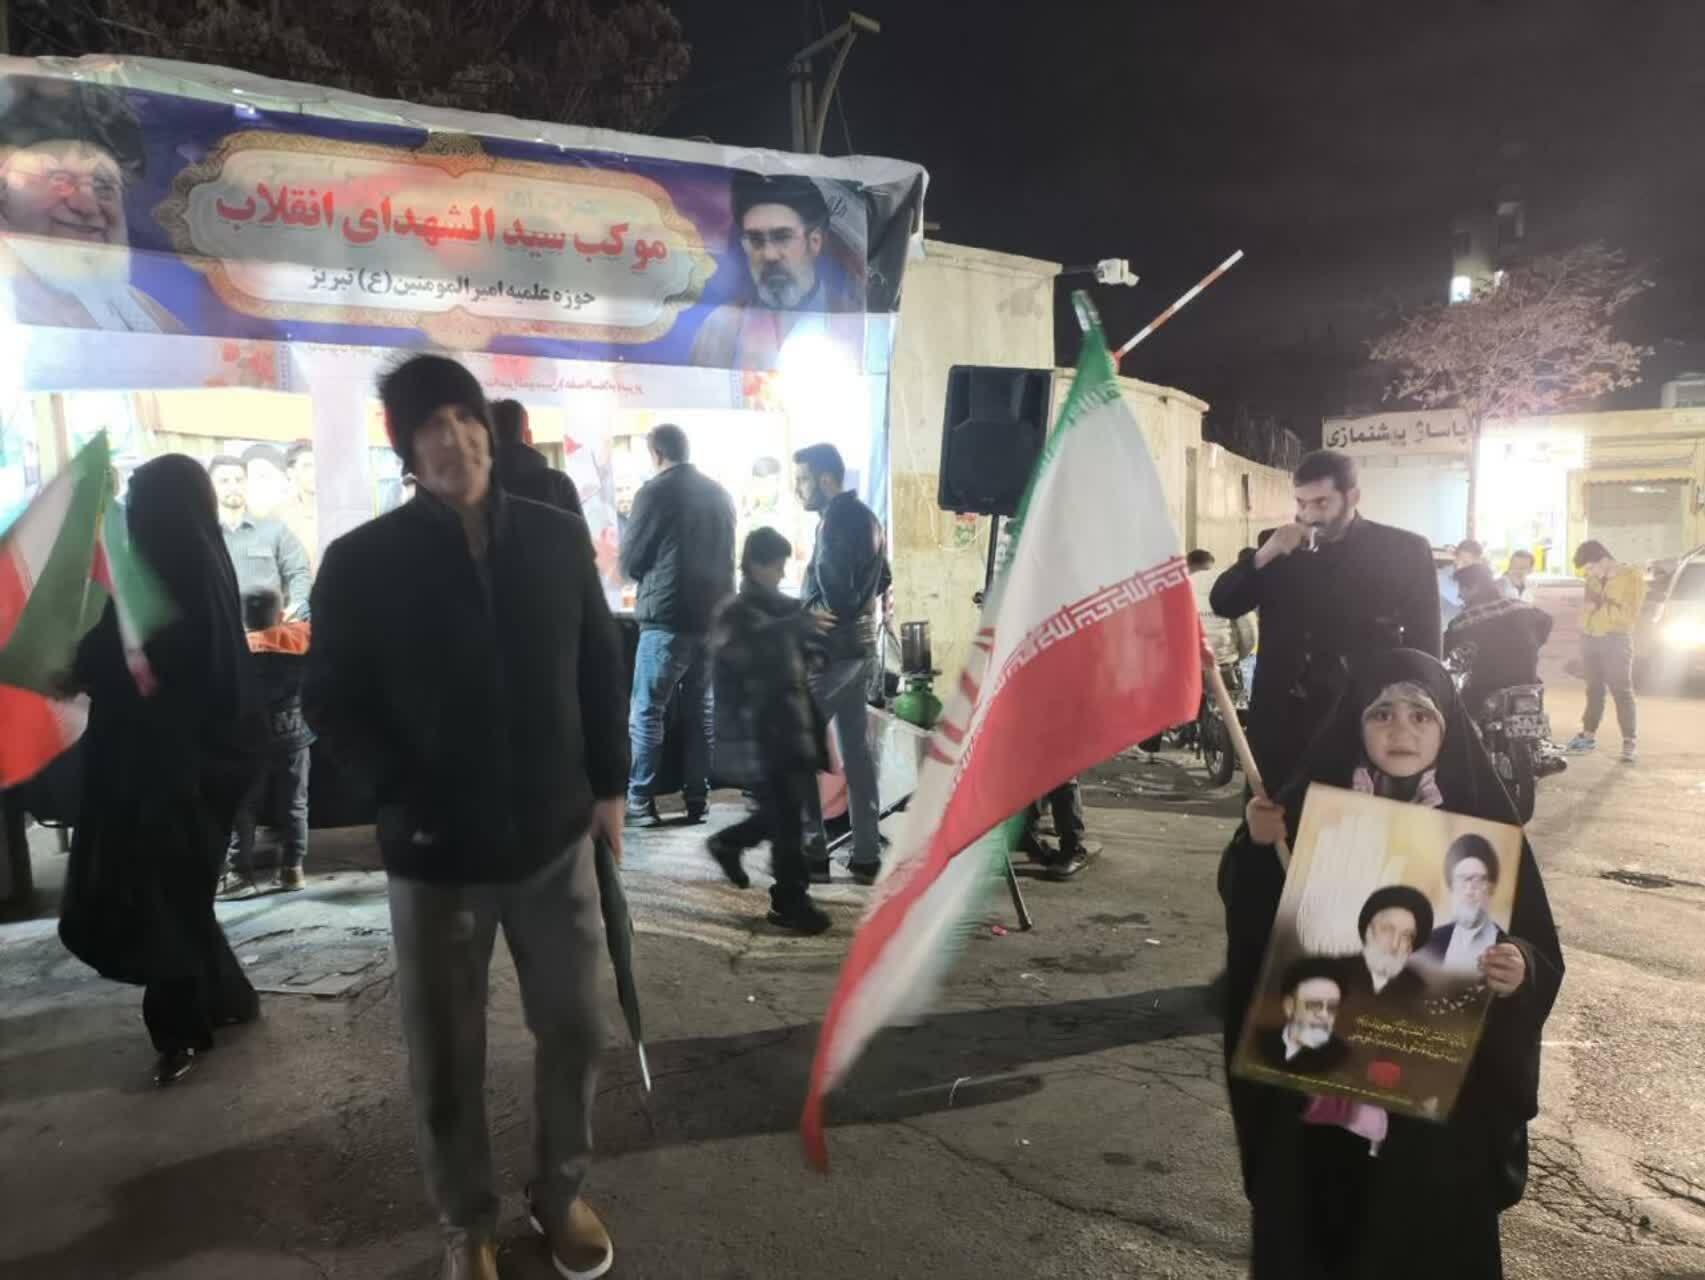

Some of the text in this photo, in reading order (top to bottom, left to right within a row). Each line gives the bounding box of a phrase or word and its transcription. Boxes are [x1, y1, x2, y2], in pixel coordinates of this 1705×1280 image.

[215, 181, 334, 232] انقلاب
[342, 195, 496, 247] الشهدای
[502, 219, 566, 258] سید
[308, 267, 355, 290] تبریز
[471, 281, 503, 301] امیر
[506, 283, 550, 304] علمیه
[553, 289, 596, 310] حوزه
[1413, 419, 1468, 446] پاساژ
